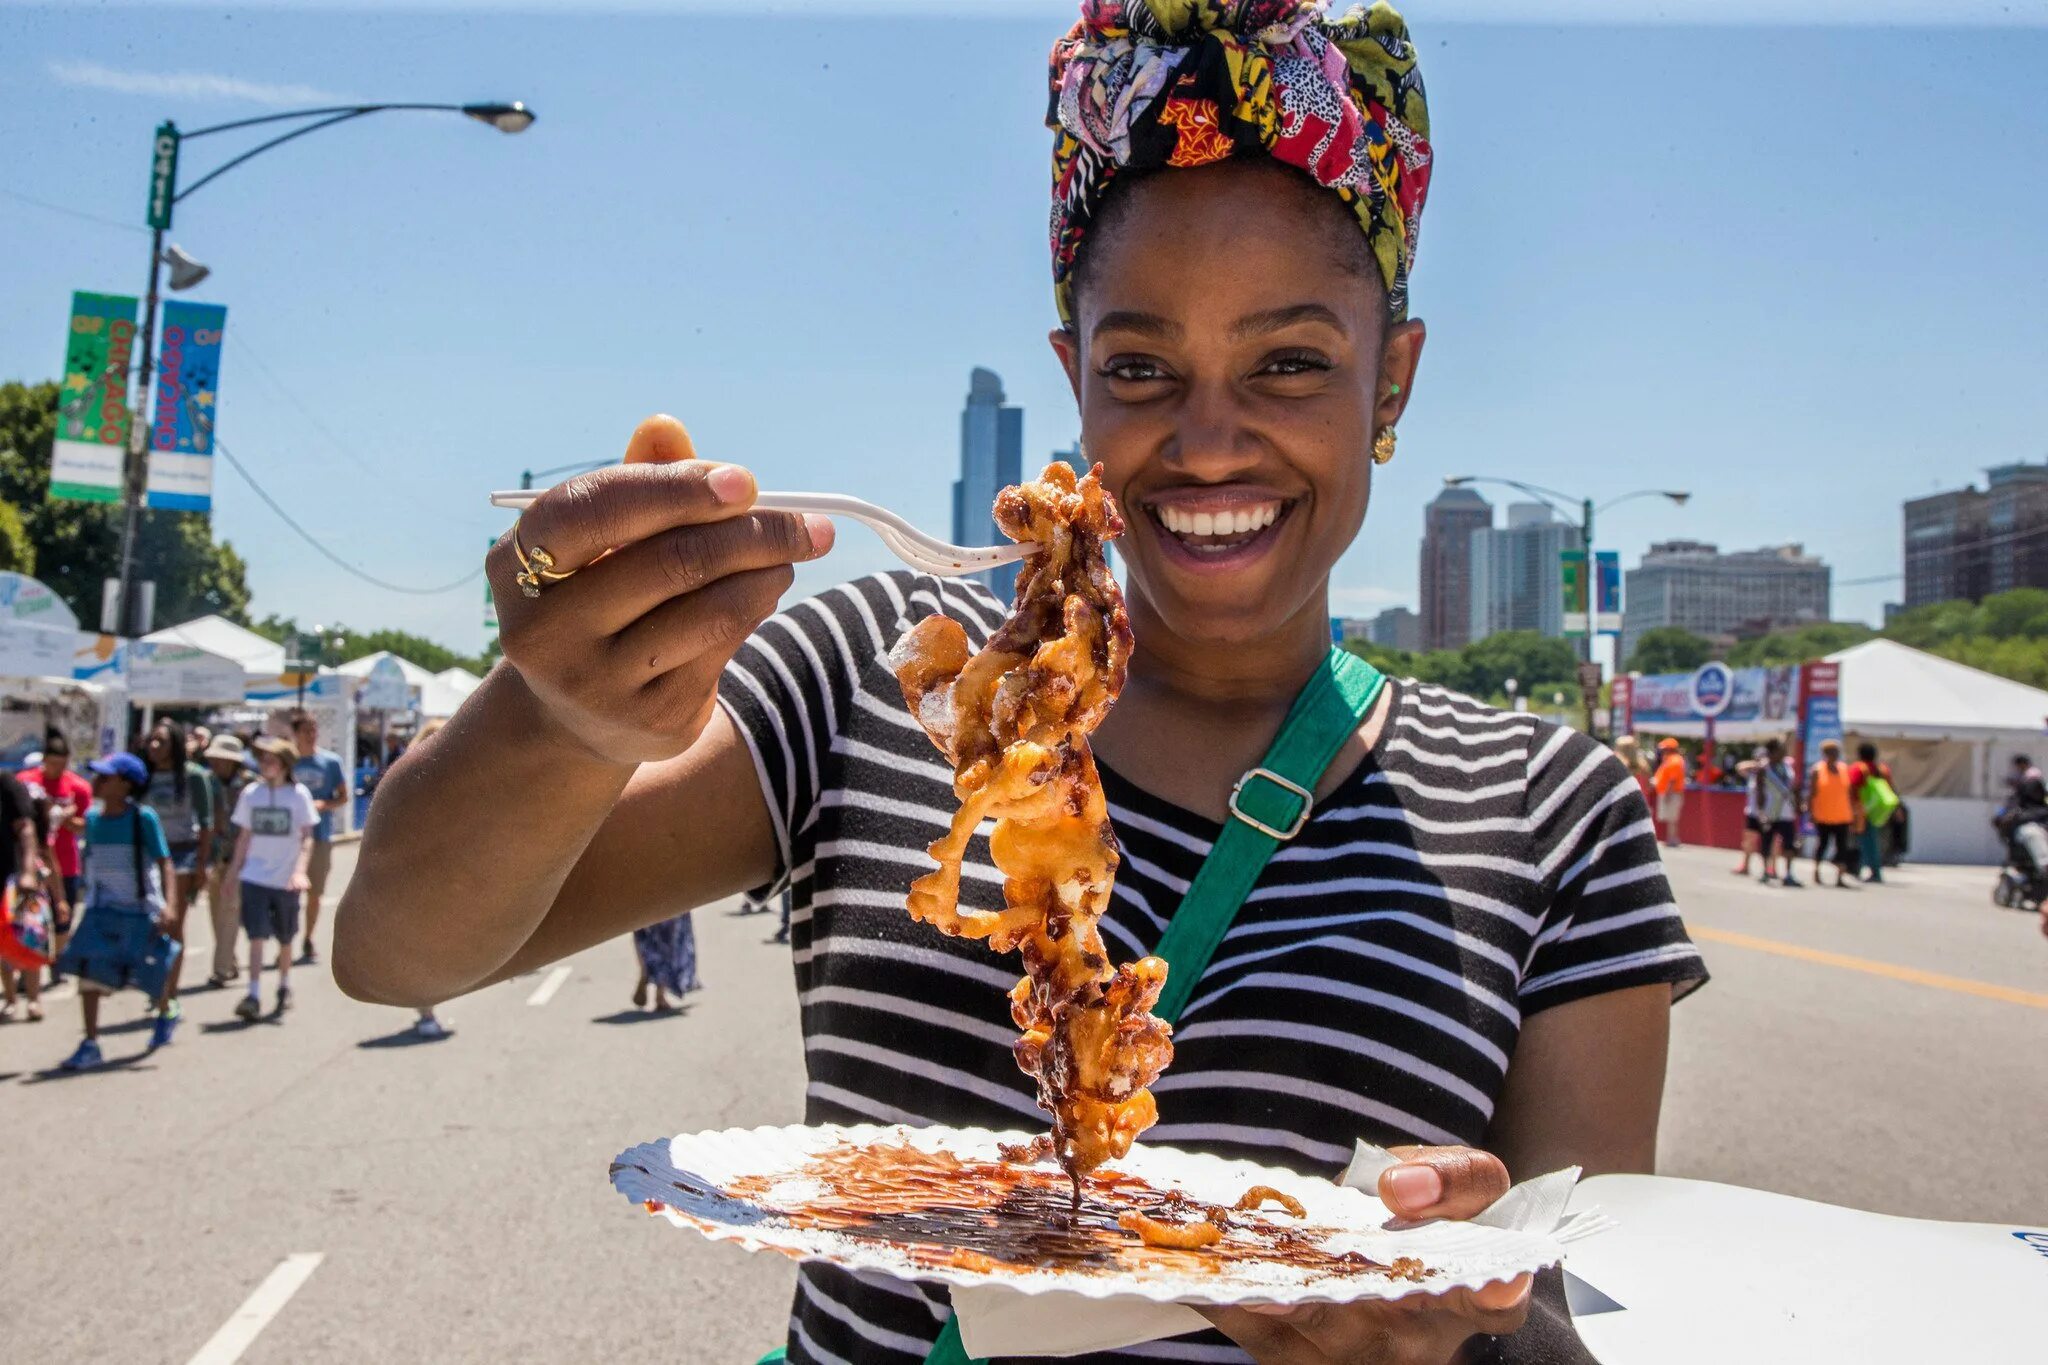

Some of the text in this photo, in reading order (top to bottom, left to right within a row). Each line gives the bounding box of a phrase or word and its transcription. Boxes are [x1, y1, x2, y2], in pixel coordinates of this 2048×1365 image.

[72, 315, 103, 334] OF
[193, 328, 222, 346] OF
[99, 319, 135, 445] CHICAGO
[153, 325, 185, 451] CHICAGO
